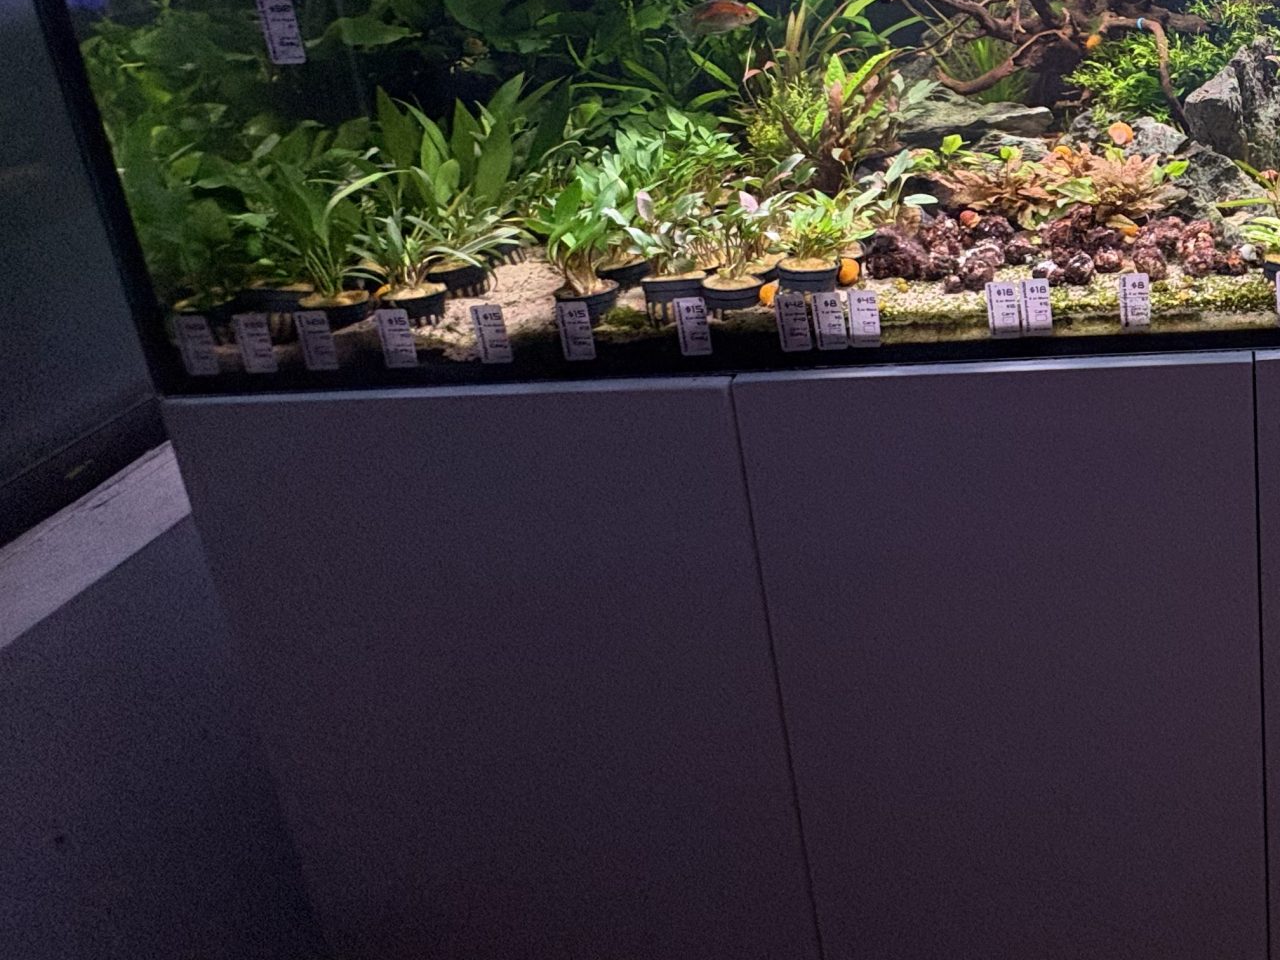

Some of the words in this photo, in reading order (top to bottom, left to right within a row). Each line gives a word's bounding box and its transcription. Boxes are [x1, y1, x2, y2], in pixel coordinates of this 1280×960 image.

[1131, 281, 1145, 289] $8
[997, 288, 1014, 296] $18
[1029, 286, 1047, 294] $18
[824, 299, 837, 308] $8
[482, 312, 501, 321] $15
[568, 309, 586, 318] $15
